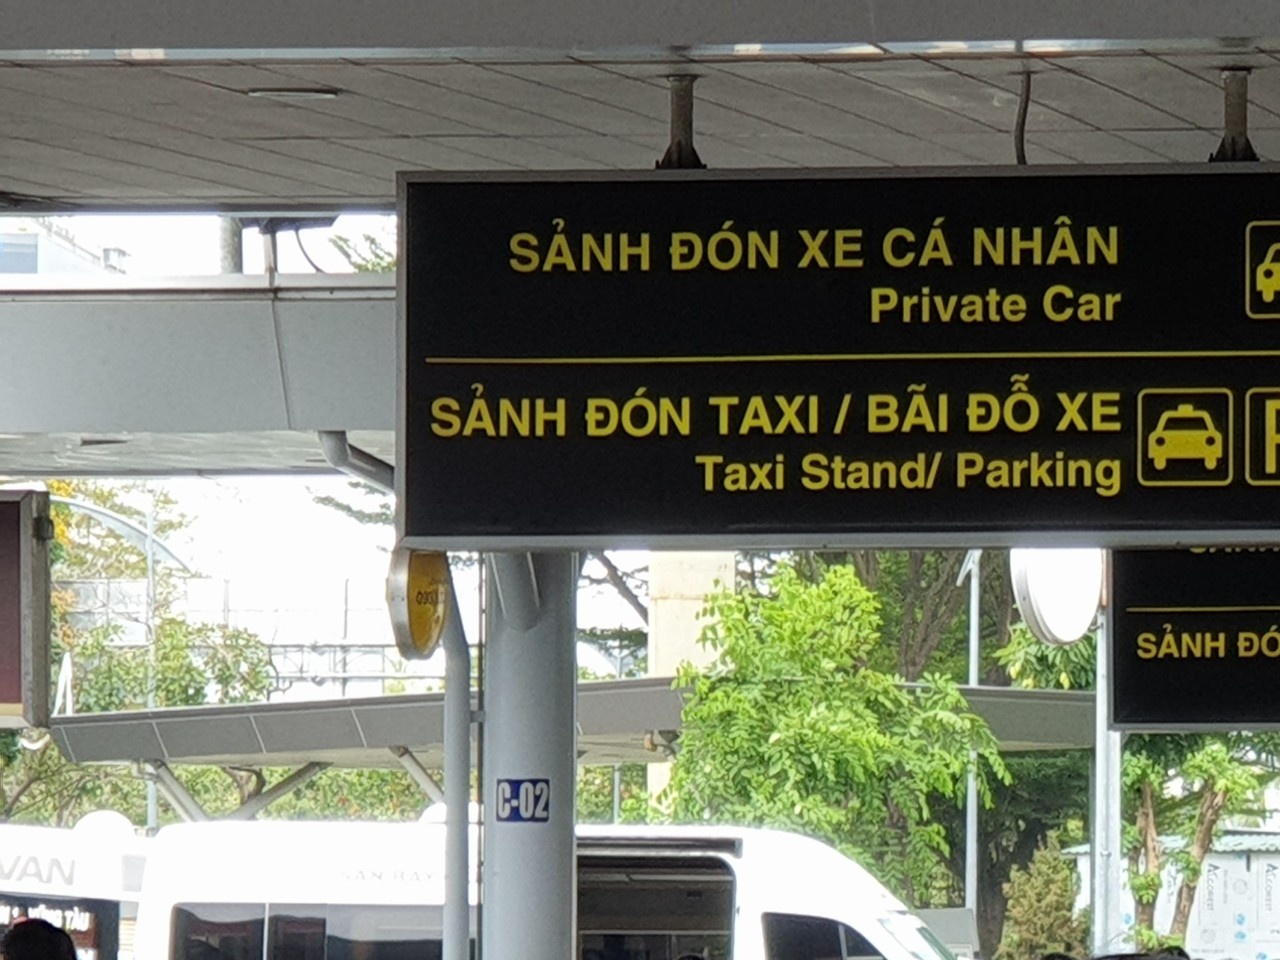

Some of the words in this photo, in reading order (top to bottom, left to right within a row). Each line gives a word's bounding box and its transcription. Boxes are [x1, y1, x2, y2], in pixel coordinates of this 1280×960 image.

[511, 219, 650, 273] SẢNH
[669, 221, 779, 271] ĐÓN
[799, 229, 864, 268] XE
[882, 218, 953, 268] CÁ
[973, 216, 1118, 266] NHÂN
[871, 287, 1027, 323] Private
[1042, 284, 1122, 322] Car
[431, 383, 566, 437] SẢNH
[584, 387, 691, 438] ĐÓN
[708, 394, 819, 435] TAXI
[833, 393, 852, 435] /
[867, 383, 948, 433] BÃI
[965, 373, 1040, 433] ĐỖ
[1056, 391, 1122, 432] XE
[694, 453, 785, 492] Taxi
[801, 450, 943, 491] Stand/
[956, 450, 1121, 497] Parking
[1136, 623, 1226, 659] SẢNH
[498, 781, 548, 819] C-02
